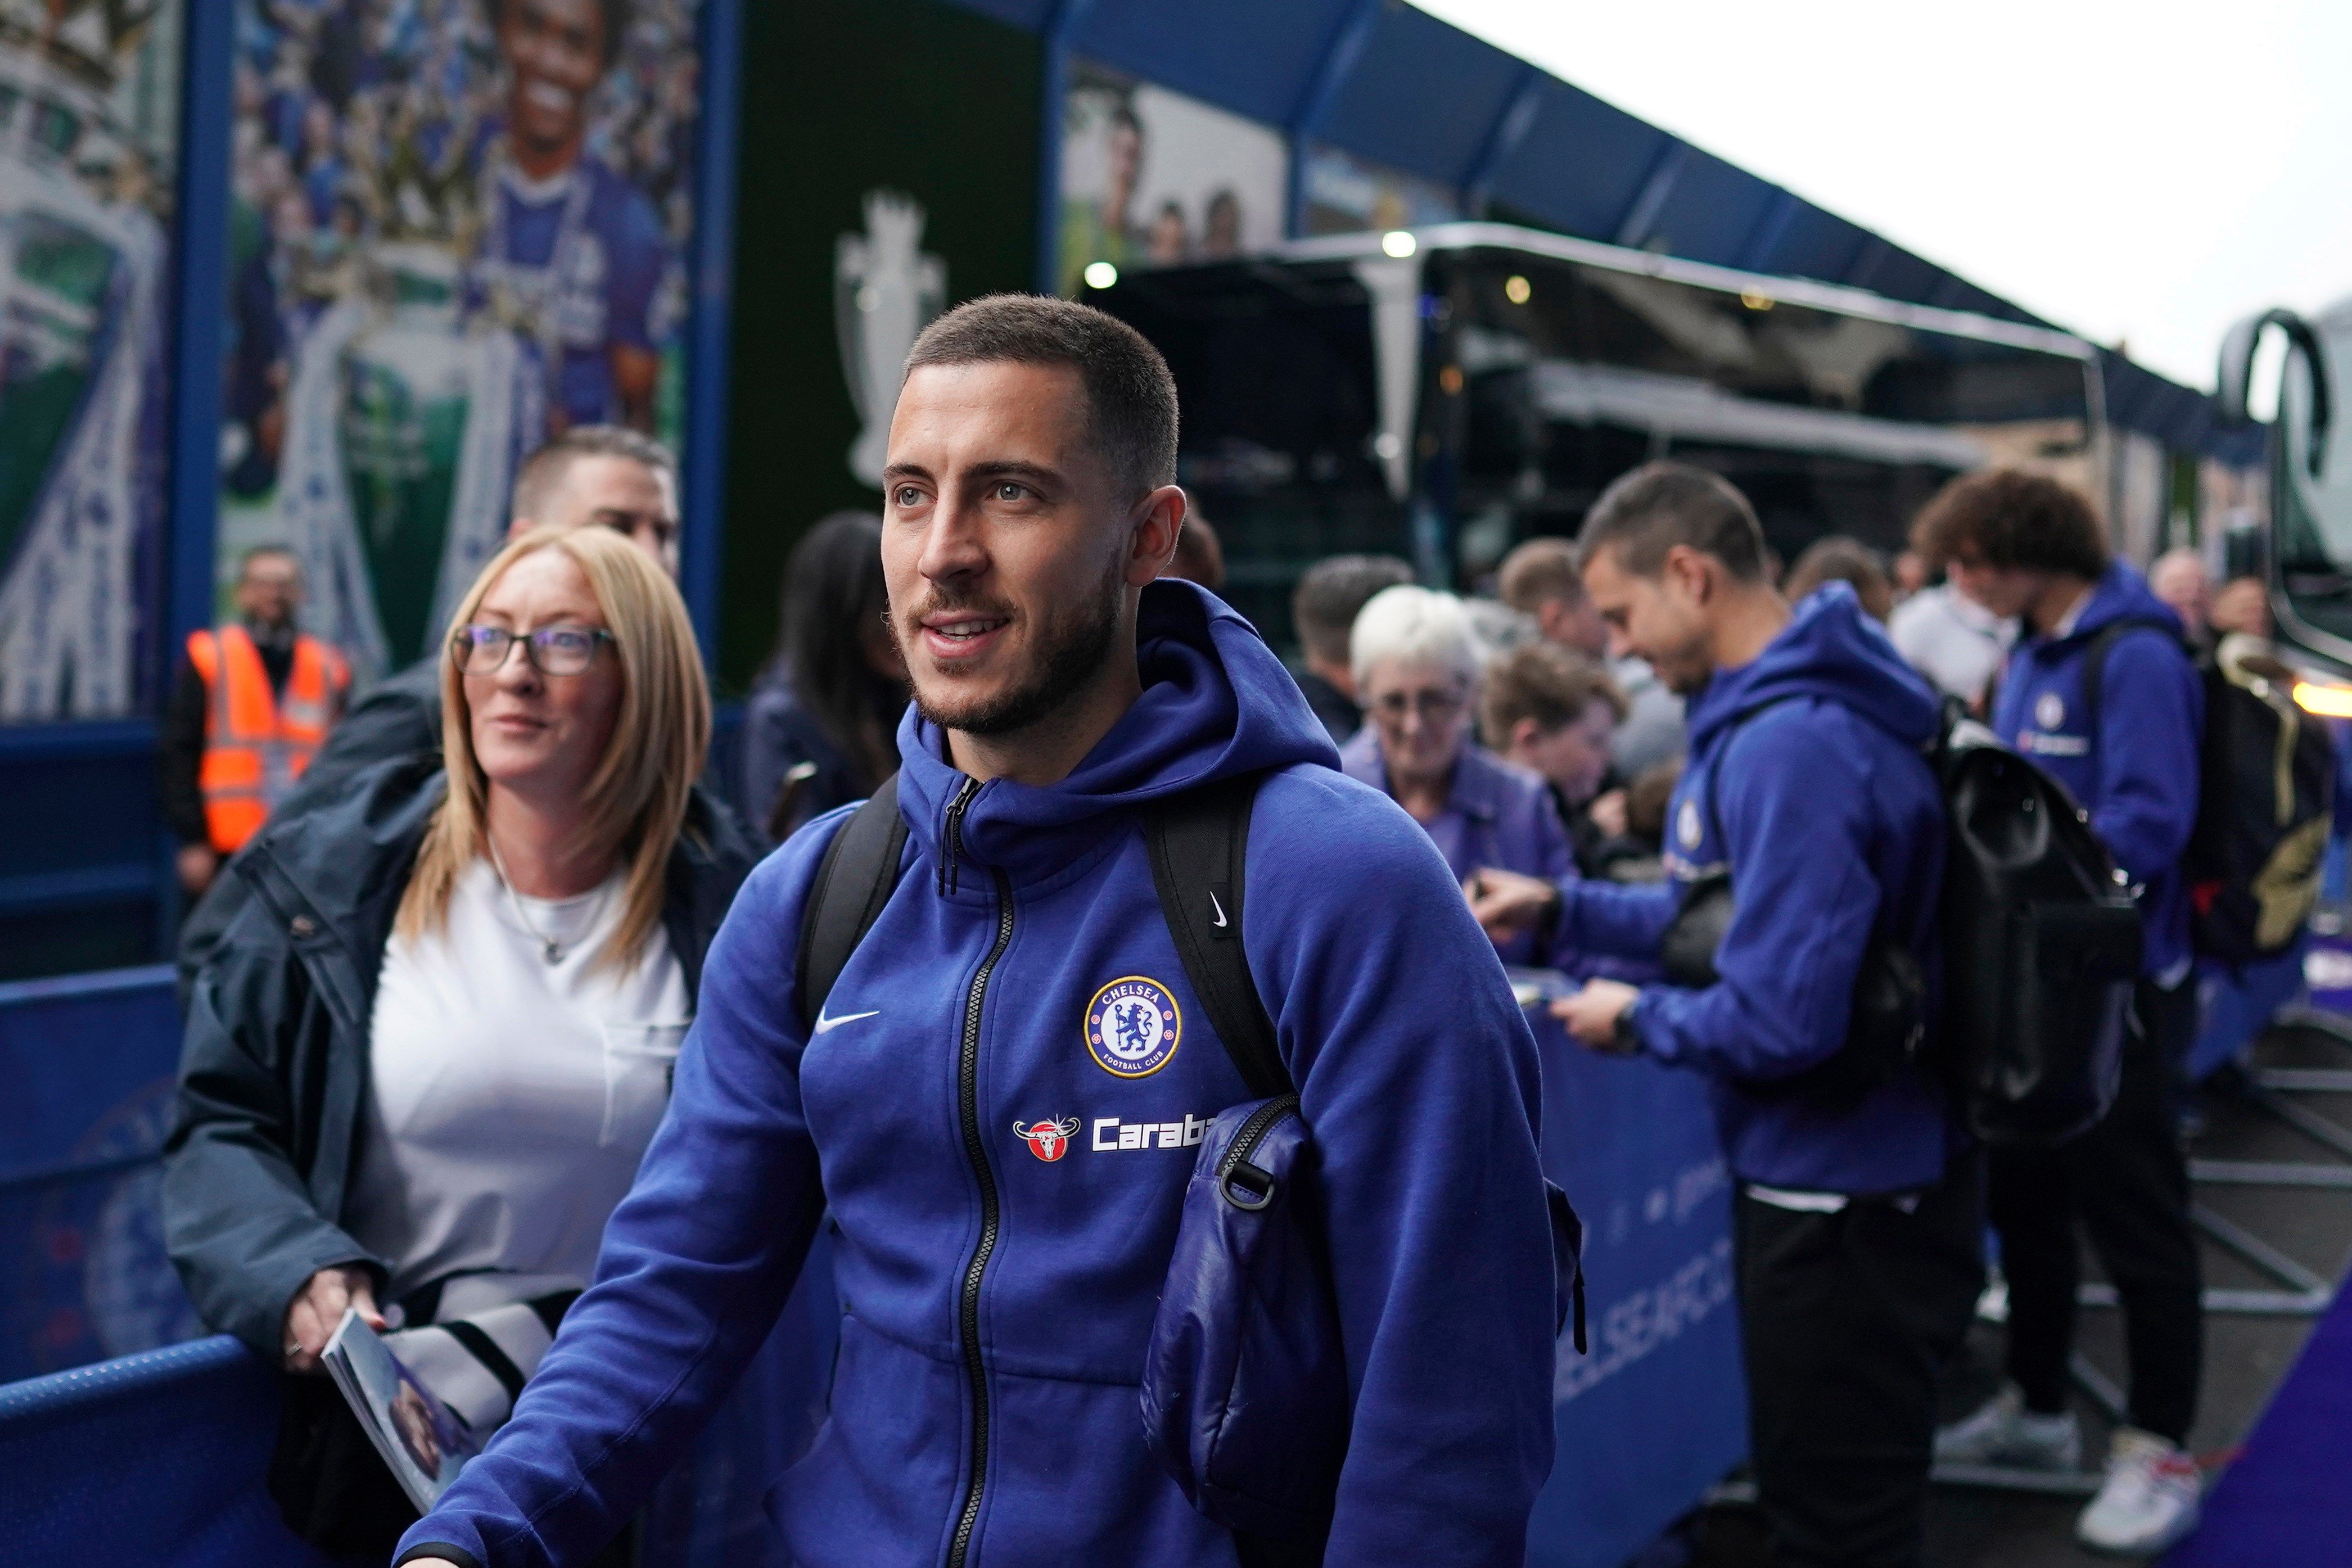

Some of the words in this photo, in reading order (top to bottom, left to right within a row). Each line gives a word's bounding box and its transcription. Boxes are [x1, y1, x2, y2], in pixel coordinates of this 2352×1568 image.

[1102, 985, 1159, 1005] CHELSEA
[1104, 1054, 1142, 1070] FOOTBALL
[1145, 1050, 1163, 1067] CLUB
[1092, 1114, 1216, 1151] Carab
